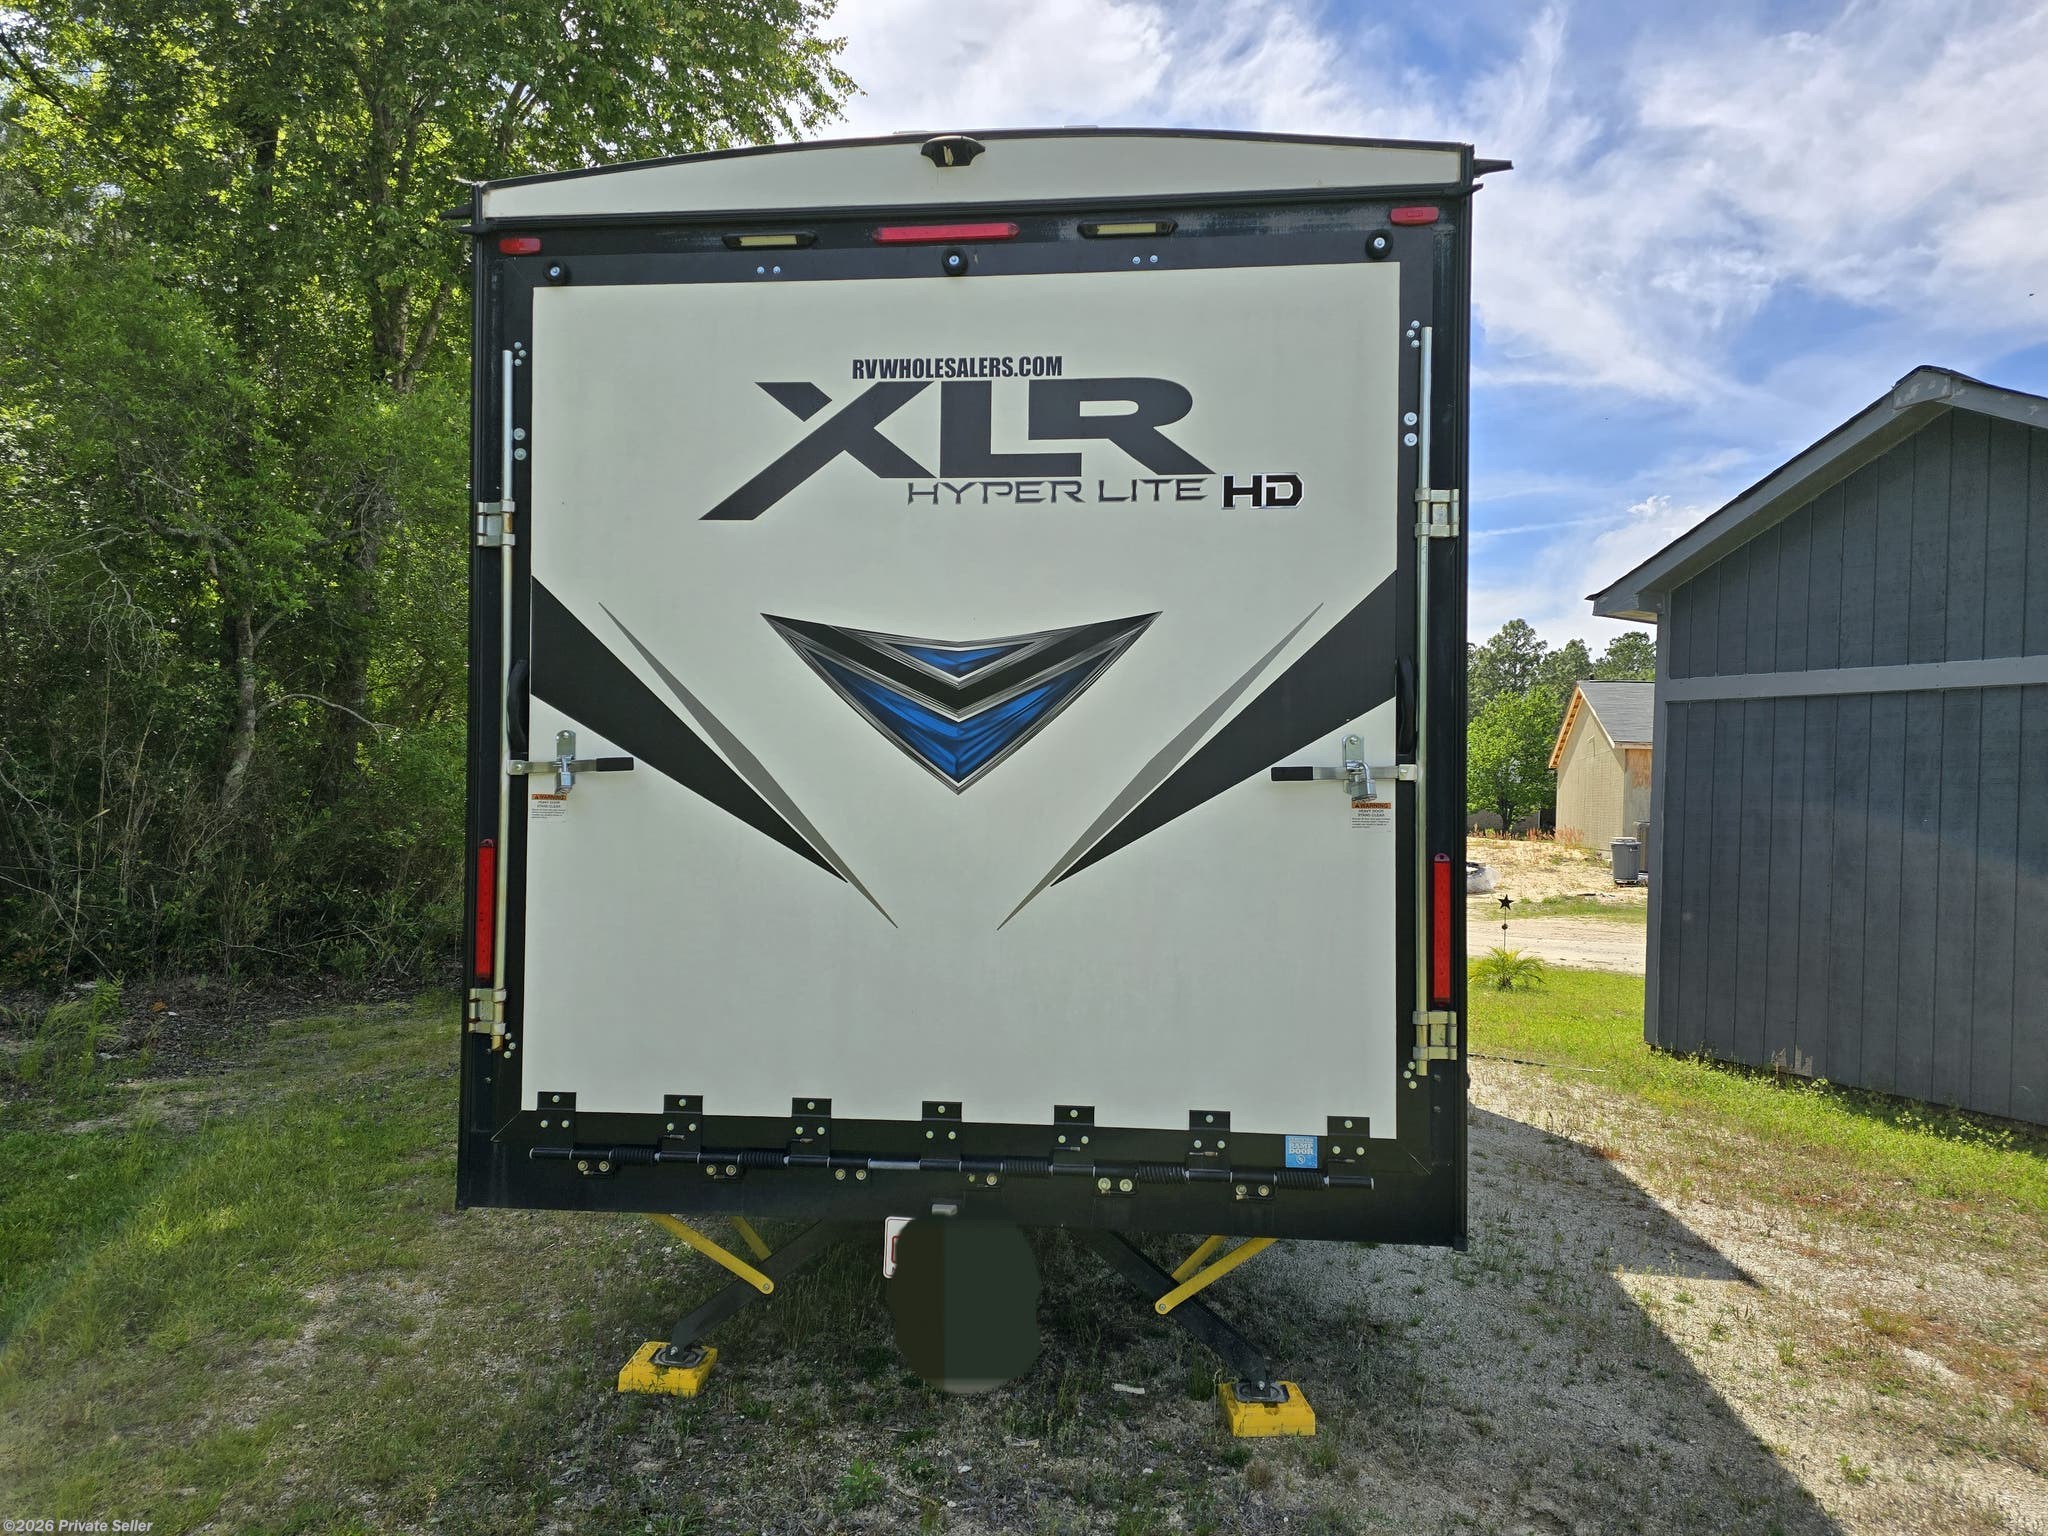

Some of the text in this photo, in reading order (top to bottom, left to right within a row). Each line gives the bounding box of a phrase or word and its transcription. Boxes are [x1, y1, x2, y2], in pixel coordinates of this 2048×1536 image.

[852, 355, 1063, 380] RVWHOLESALERS.COM
[698, 376, 1217, 521] XLR
[907, 472, 1305, 511] HYPER LITE HD
